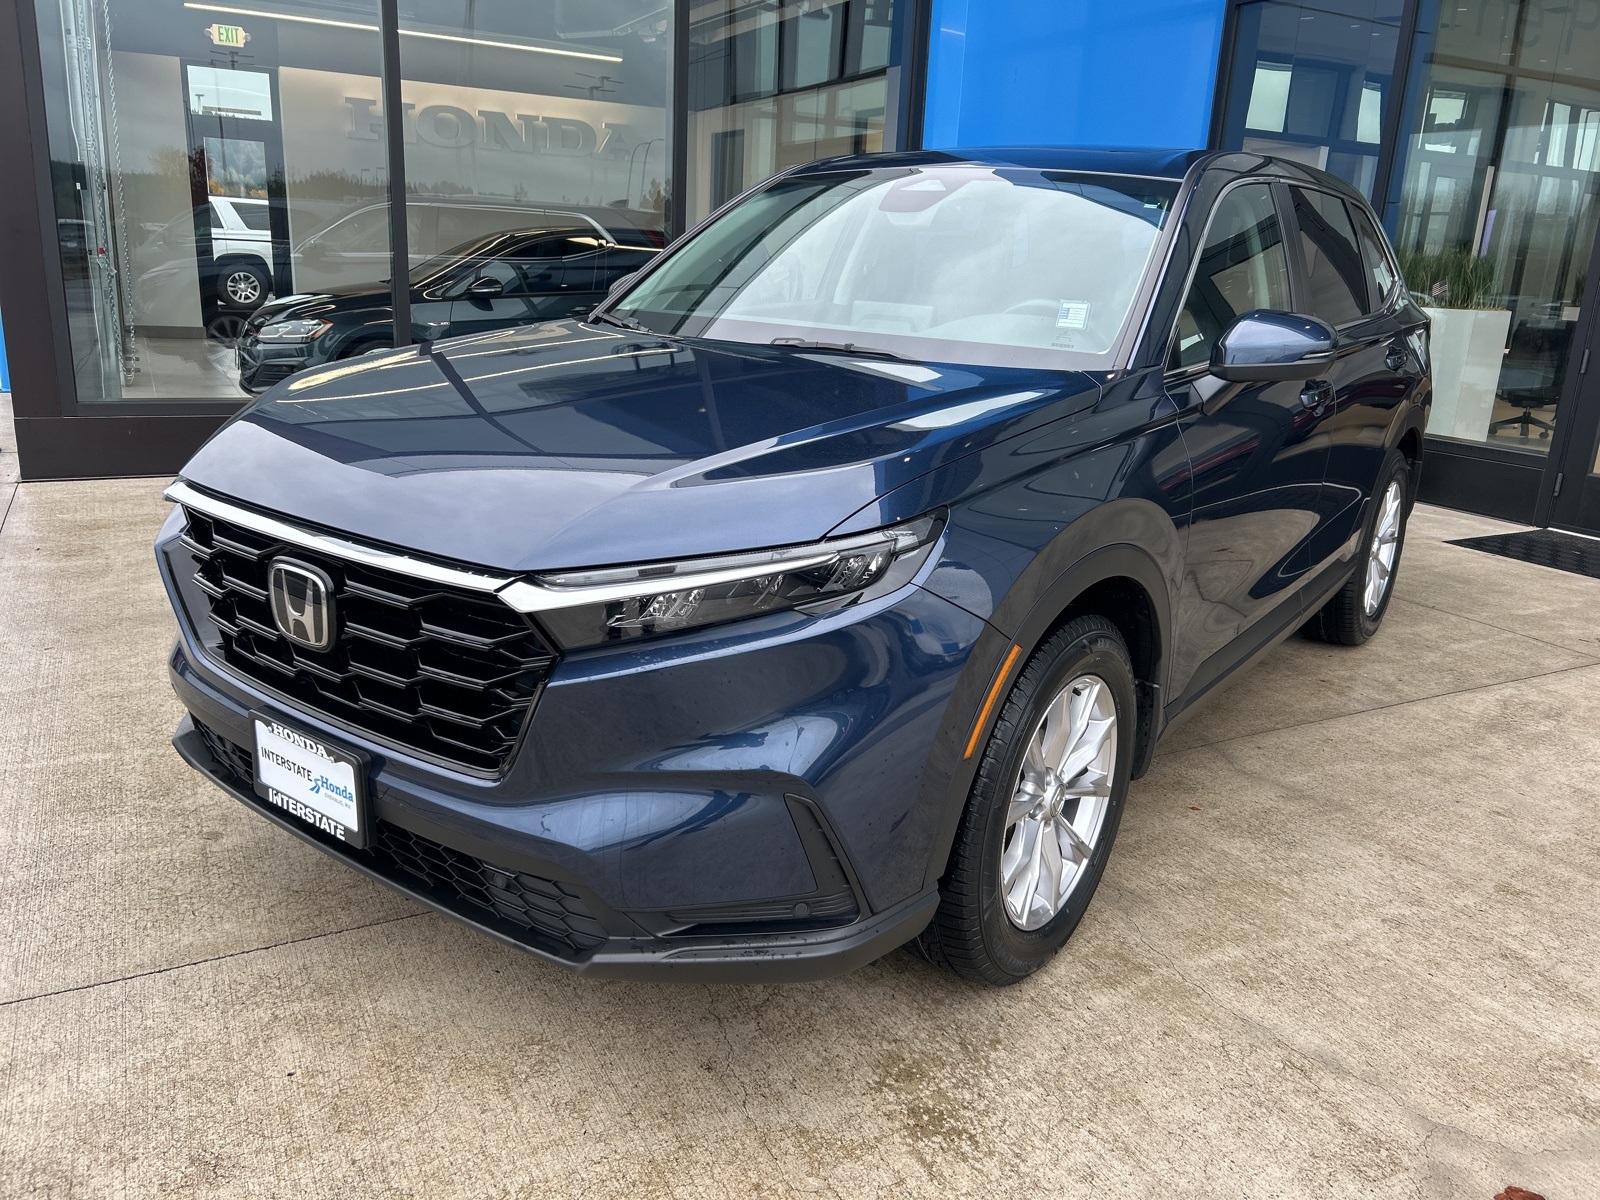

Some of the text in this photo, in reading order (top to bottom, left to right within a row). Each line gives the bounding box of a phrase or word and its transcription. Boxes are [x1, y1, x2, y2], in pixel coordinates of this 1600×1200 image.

[217, 25, 239, 43] EXIT
[344, 96, 647, 162] HONDA
[271, 722, 328, 757] HONDA
[261, 746, 313, 782] INTERSTATE
[320, 775, 354, 803] Honda
[268, 788, 345, 841] INTERSTATE
